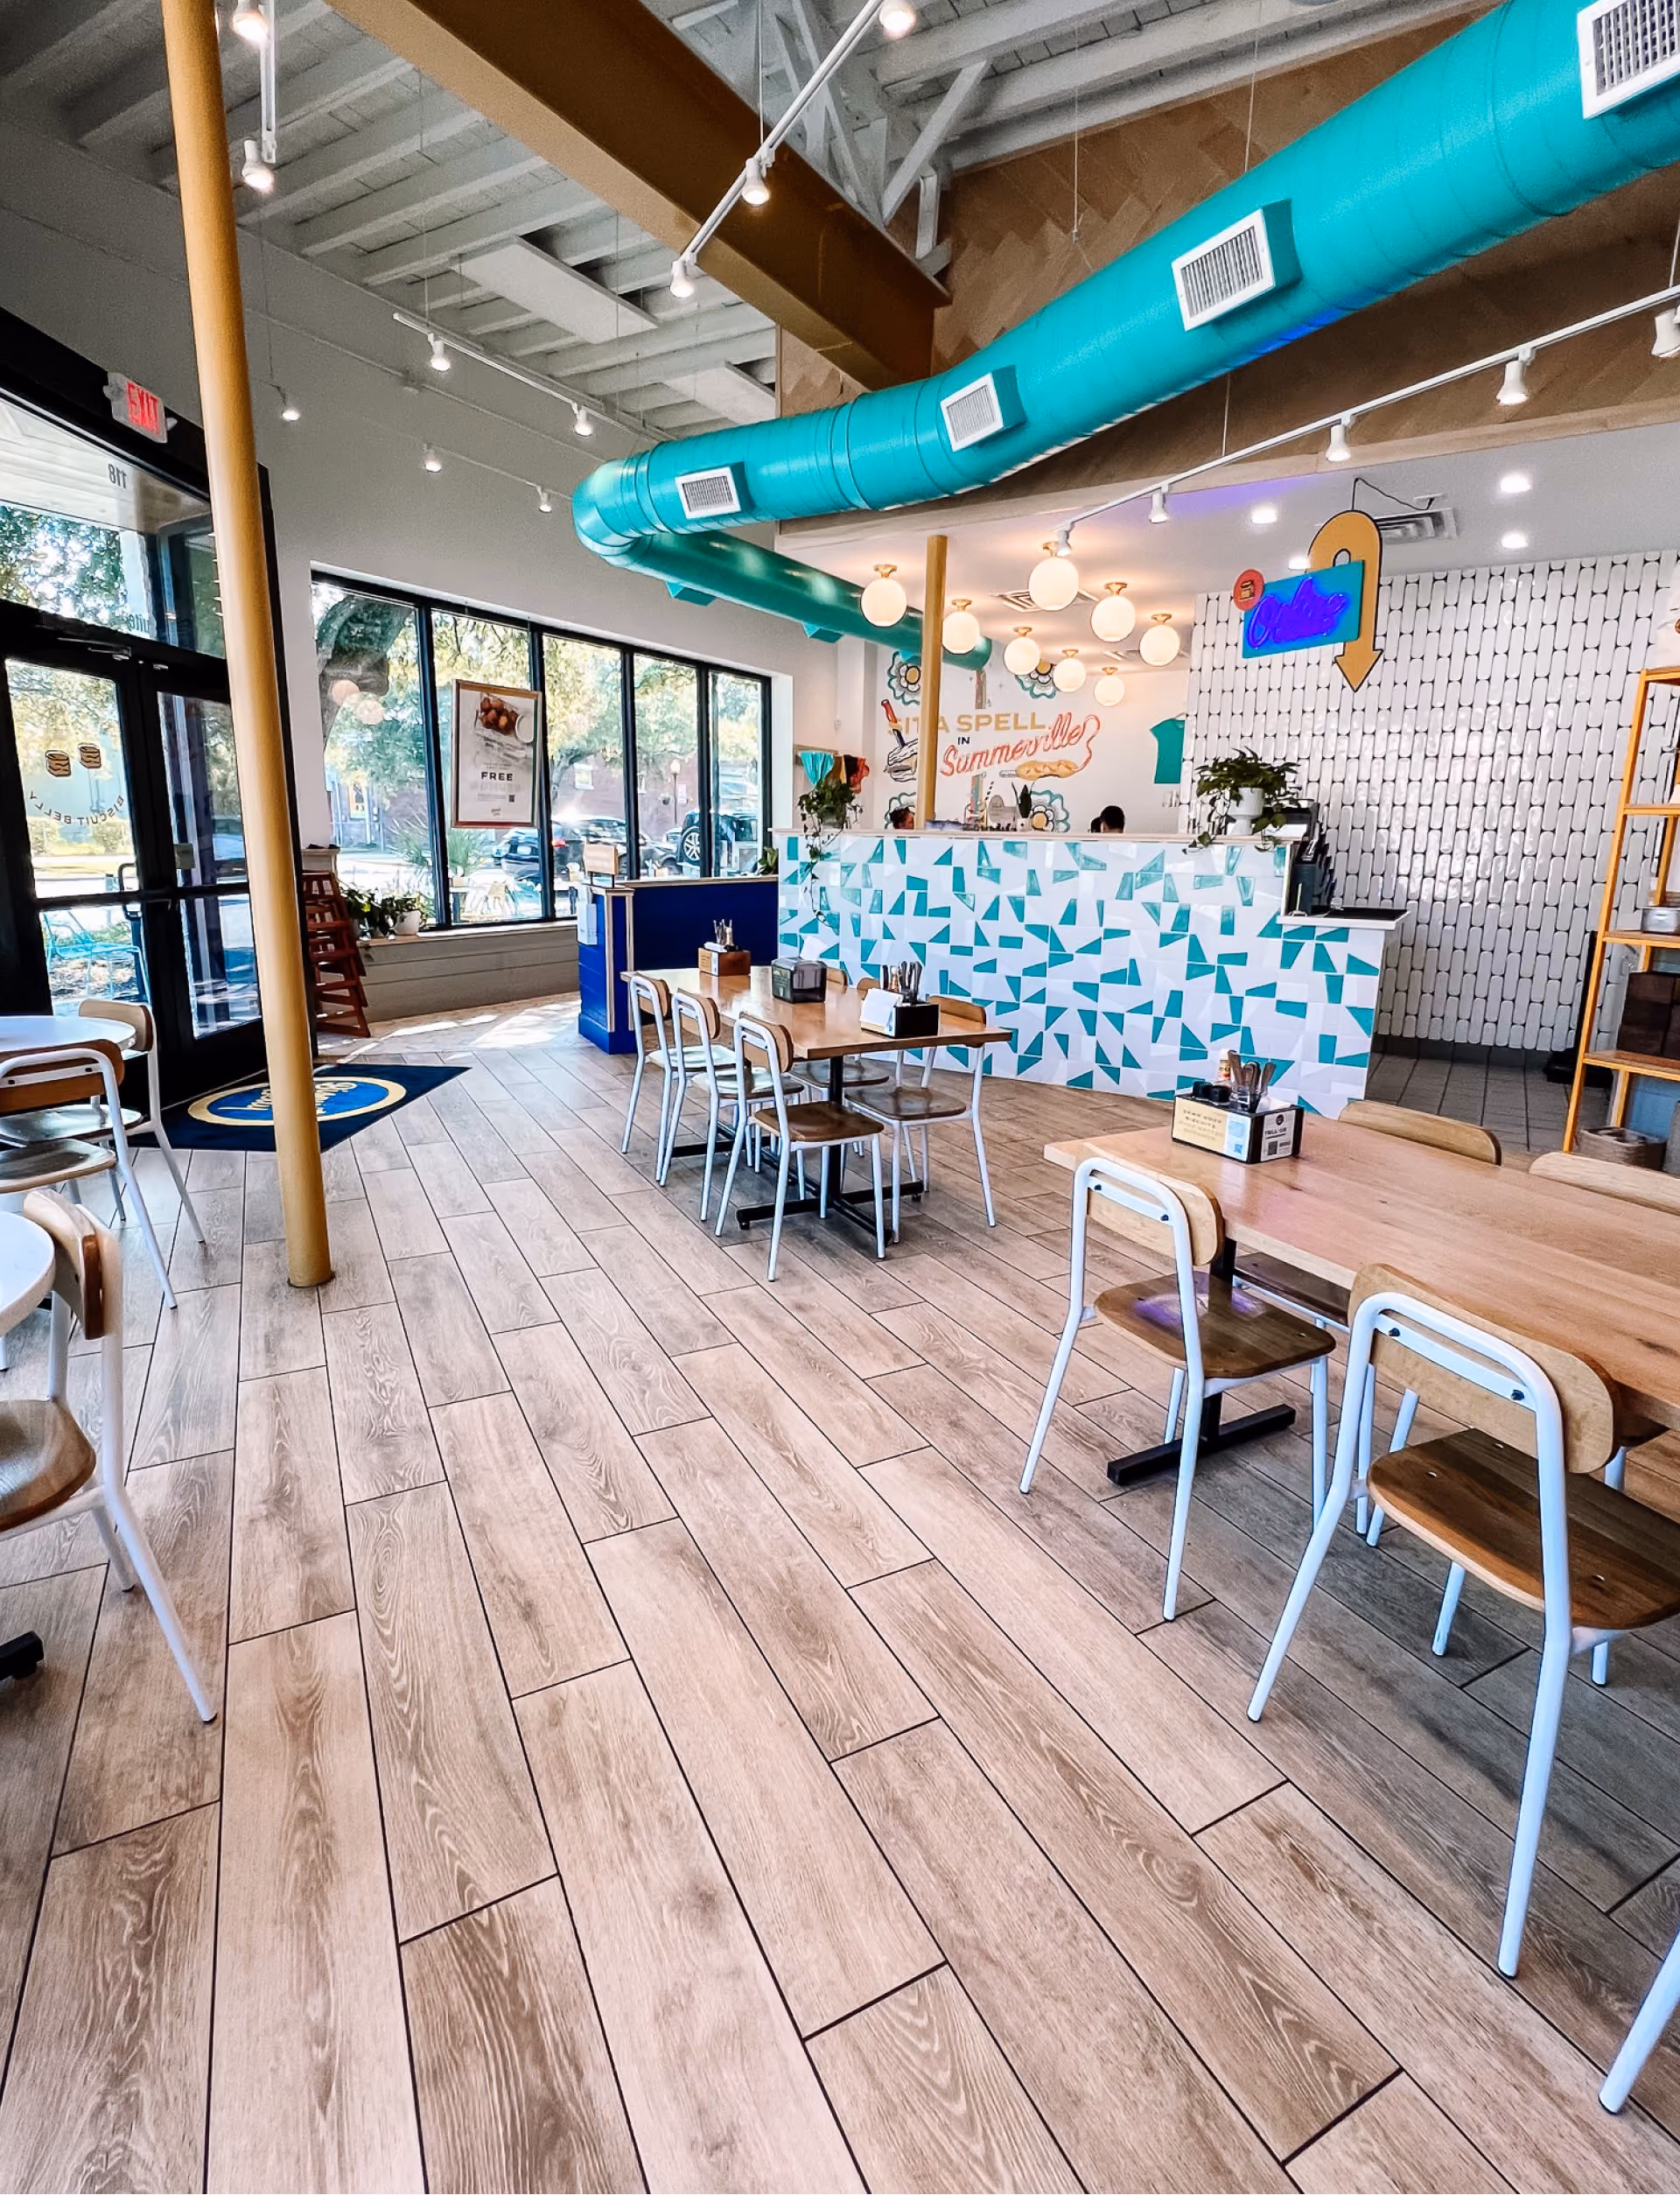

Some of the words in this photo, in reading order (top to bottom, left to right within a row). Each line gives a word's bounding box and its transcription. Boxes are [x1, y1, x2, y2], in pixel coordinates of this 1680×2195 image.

[126, 380, 159, 435] EXIT
[940, 712, 1087, 777] Summerville
[957, 736, 970, 746] IN
[481, 772, 514, 782] FREE
